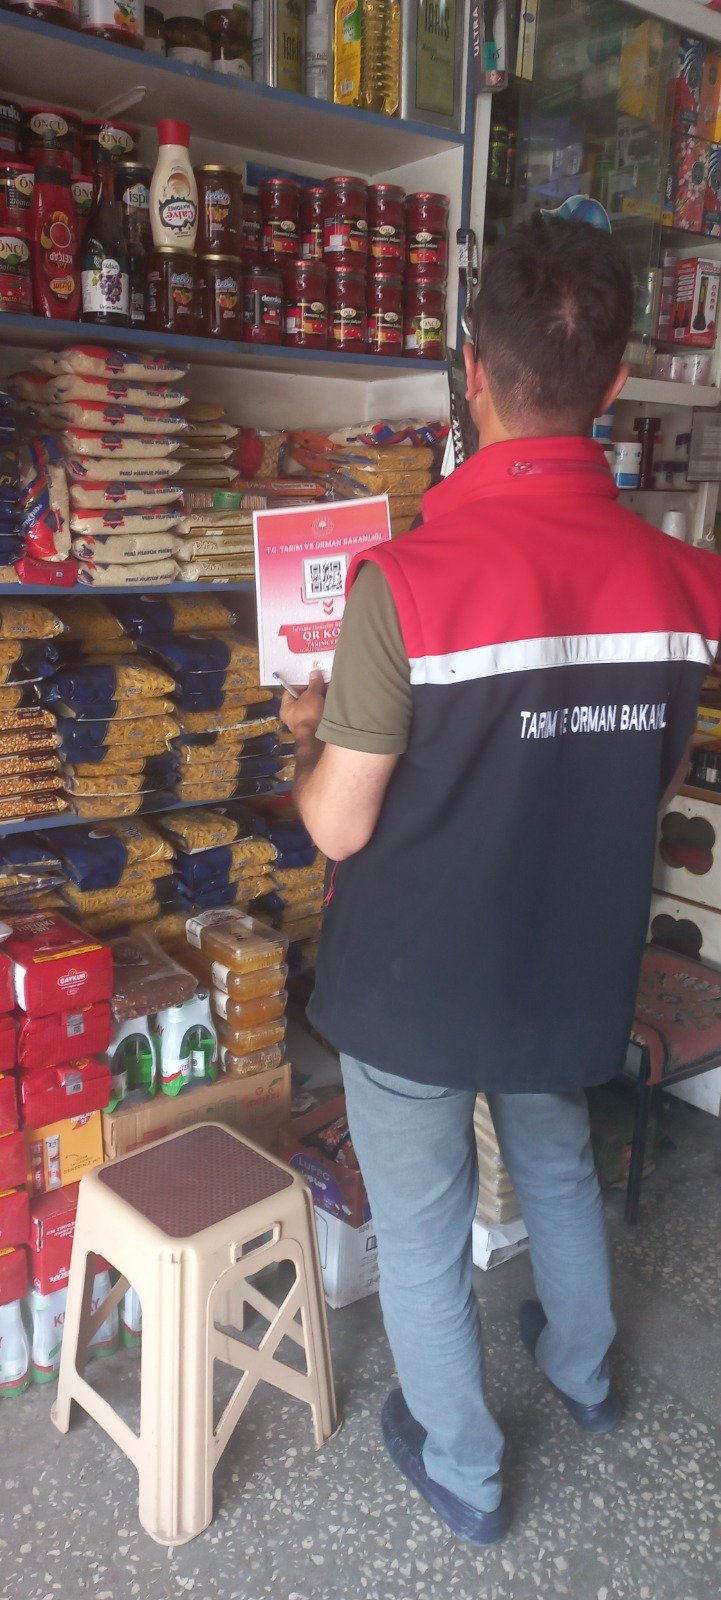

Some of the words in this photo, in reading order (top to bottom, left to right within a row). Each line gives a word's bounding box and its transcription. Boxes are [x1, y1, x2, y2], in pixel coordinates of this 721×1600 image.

[472, 6, 480, 57] ULTRA
[280, 545, 303, 553] TARIM
[314, 540, 342, 549] ORMAN
[303, 630, 320, 641] QR
[520, 710, 559, 739] TARIM
[571, 704, 617, 733] ORMAN
[60, 973, 86, 984] ÇAYKUR
